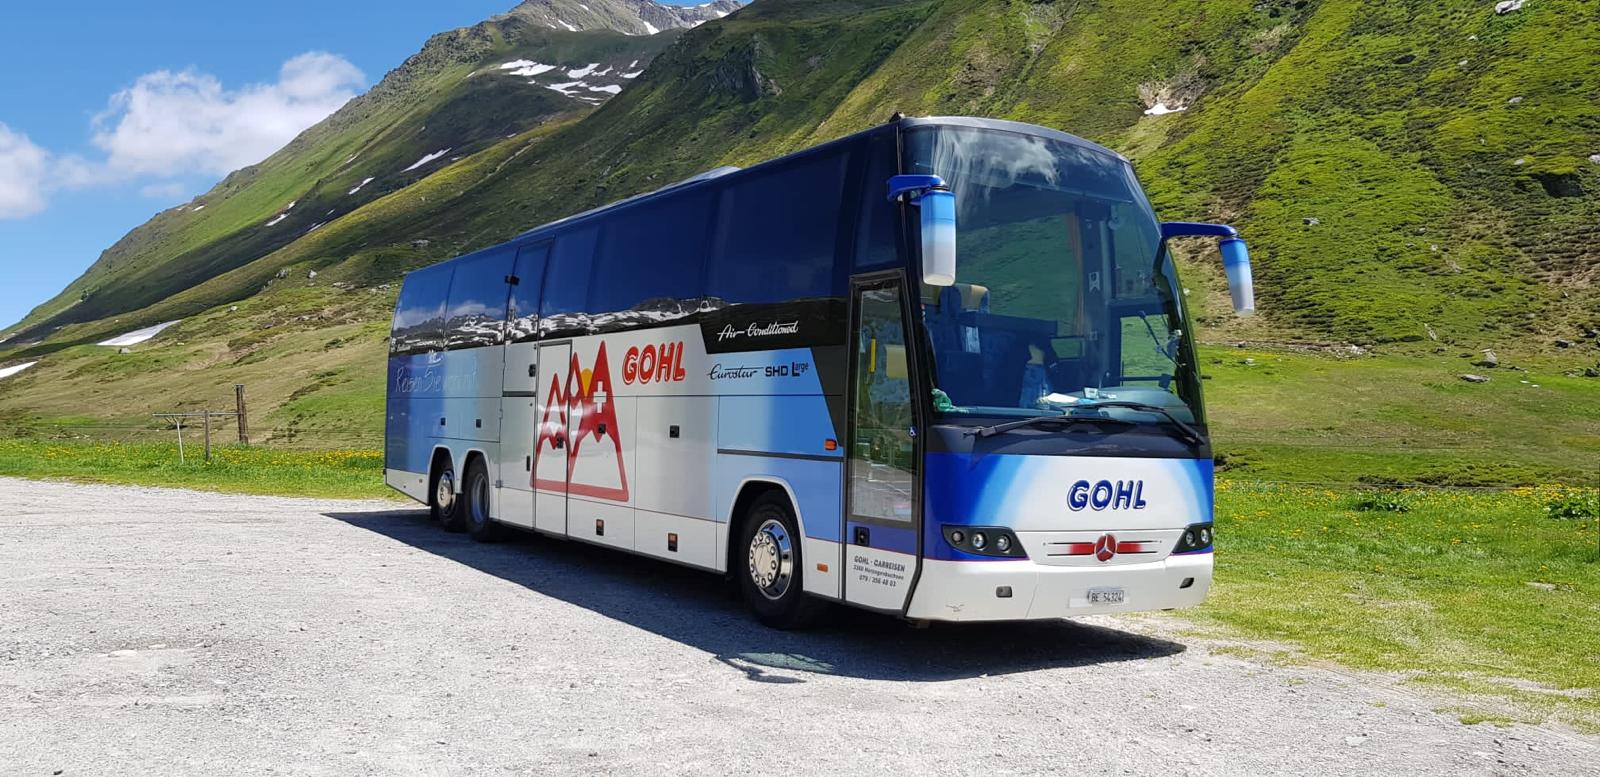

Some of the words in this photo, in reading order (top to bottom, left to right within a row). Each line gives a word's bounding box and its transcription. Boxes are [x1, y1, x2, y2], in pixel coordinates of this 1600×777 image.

[622, 340, 686, 385] GOHL
[708, 363, 763, 380] Eurostar
[765, 365, 788, 377] SHD
[1067, 480, 1146, 511] GOHL
[854, 555, 869, 565] GOHL
[873, 559, 906, 572] CARREISEN
[1091, 592, 1100, 602] BE
